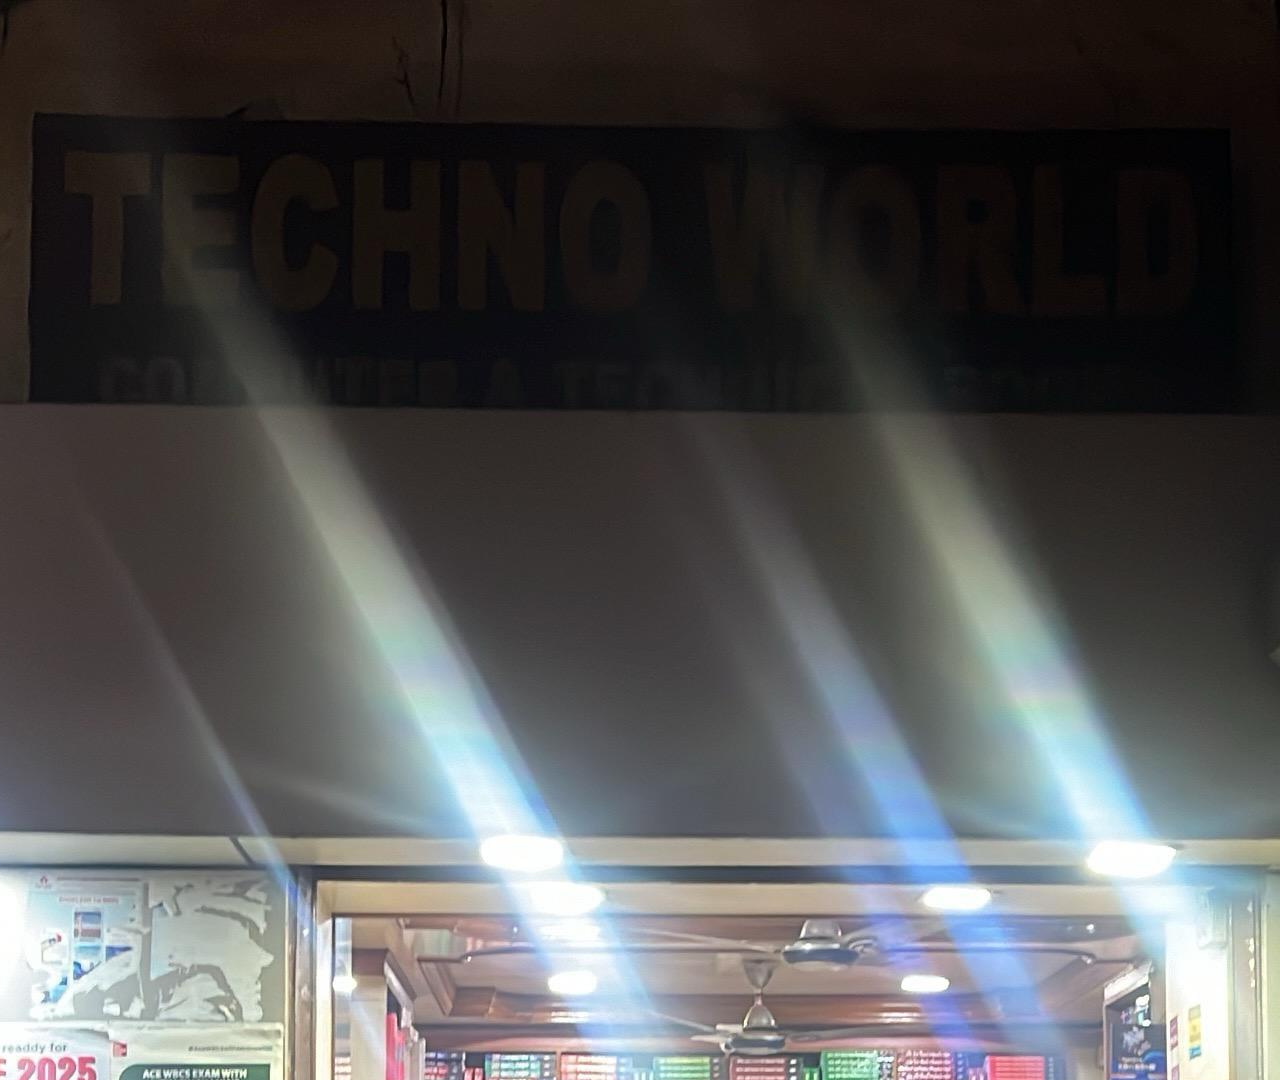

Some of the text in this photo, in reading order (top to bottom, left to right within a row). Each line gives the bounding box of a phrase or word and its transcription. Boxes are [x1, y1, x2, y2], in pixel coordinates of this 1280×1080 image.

[63, 150, 1200, 318] TECHNO WORLD
[51, 1043, 67, 1053] for
[142, 1069, 161, 1079] ACE
[193, 1069, 220, 1079] EXAM
[222, 1069, 247, 1079] WITH
